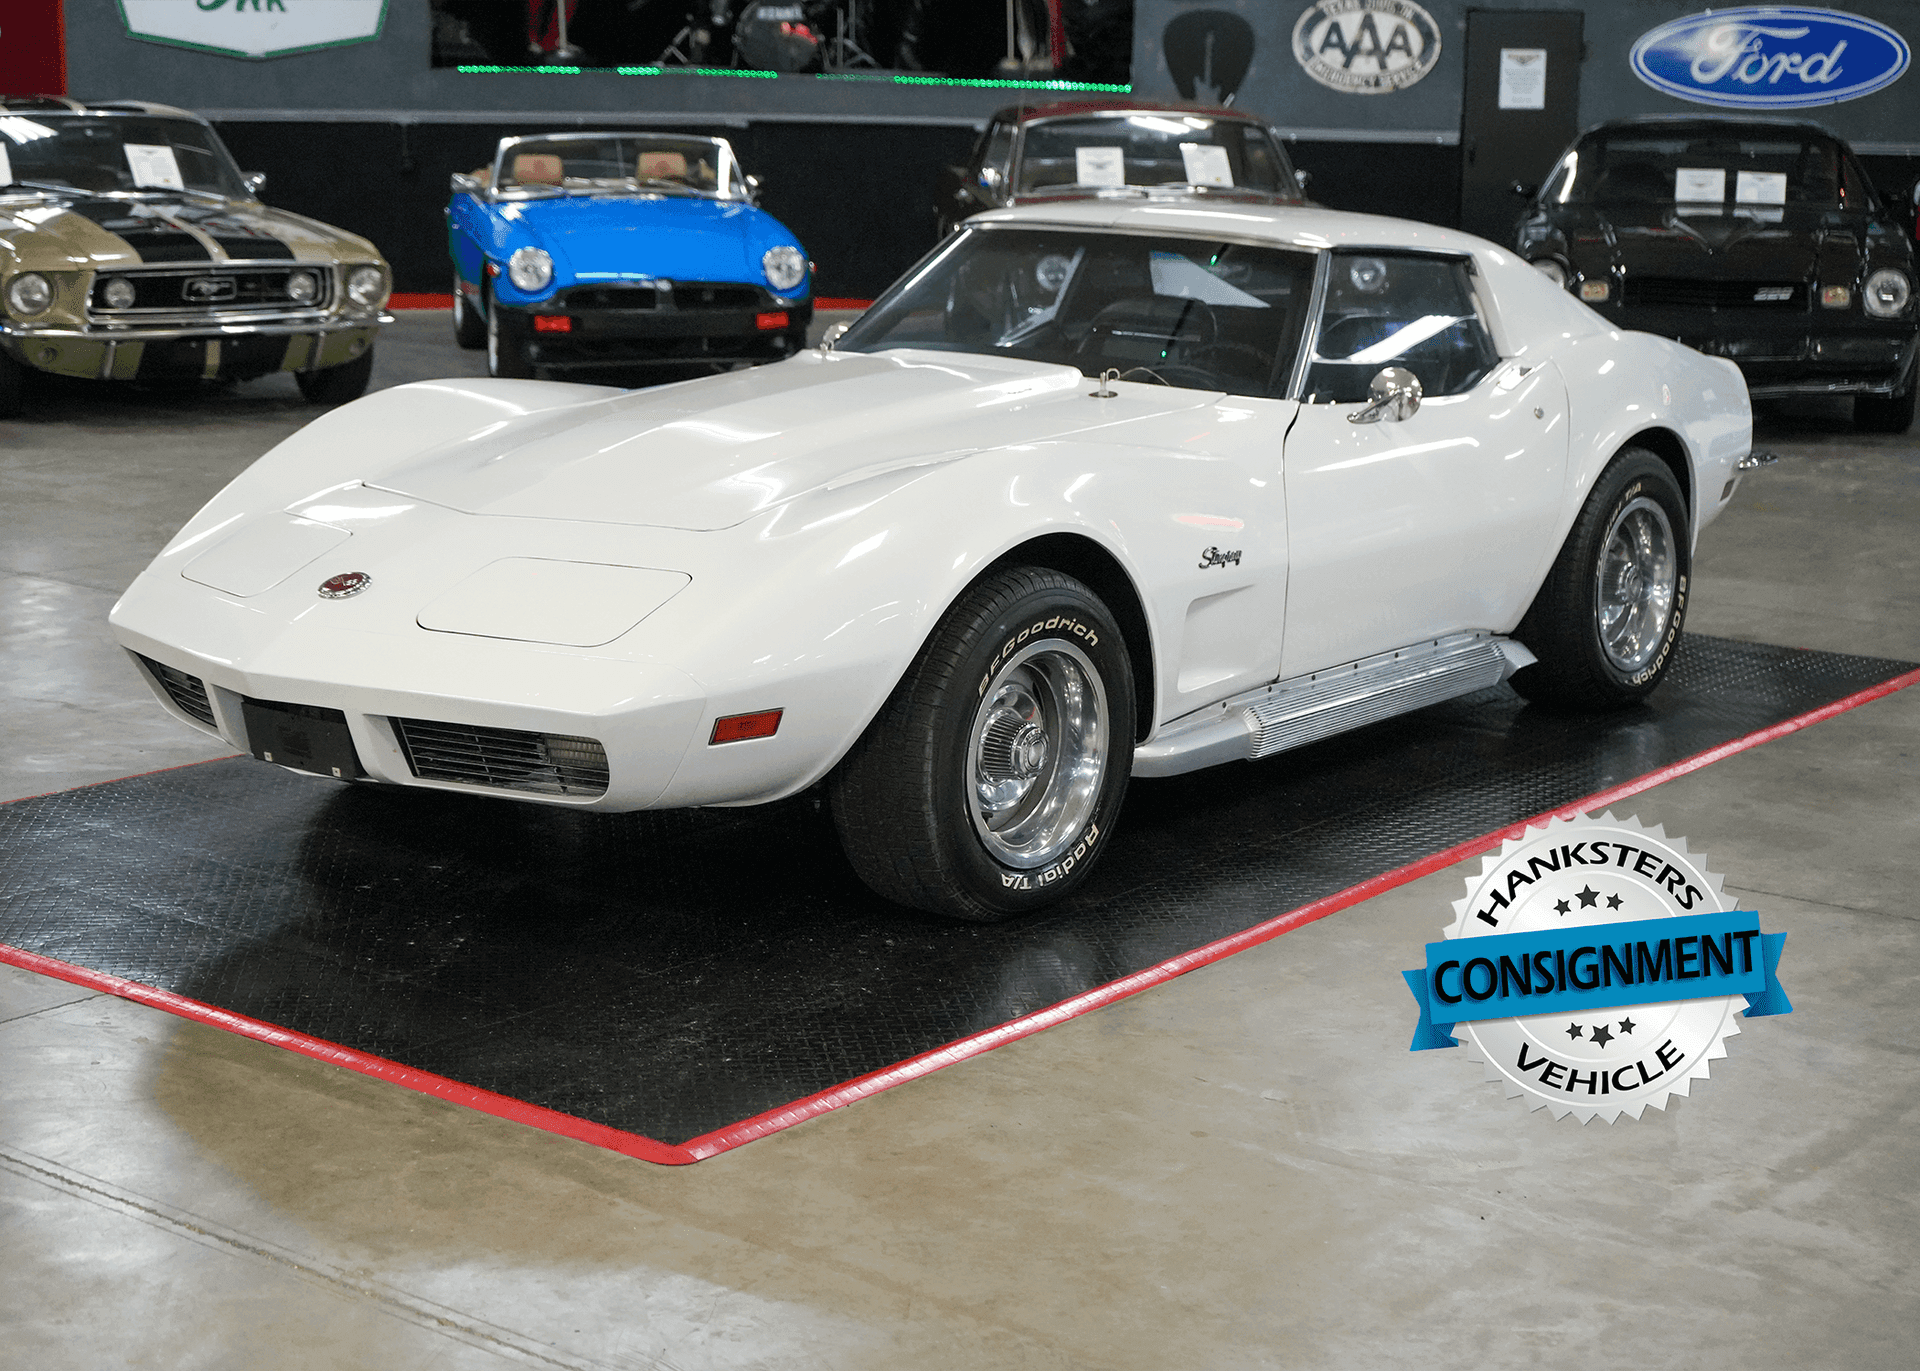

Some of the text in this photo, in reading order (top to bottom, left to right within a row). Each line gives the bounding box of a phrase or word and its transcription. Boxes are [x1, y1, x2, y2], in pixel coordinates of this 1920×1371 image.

[1319, 13, 1412, 70] AAA
[1690, 23, 1848, 84] Ford
[1001, 823, 1100, 890] Radial T/A
